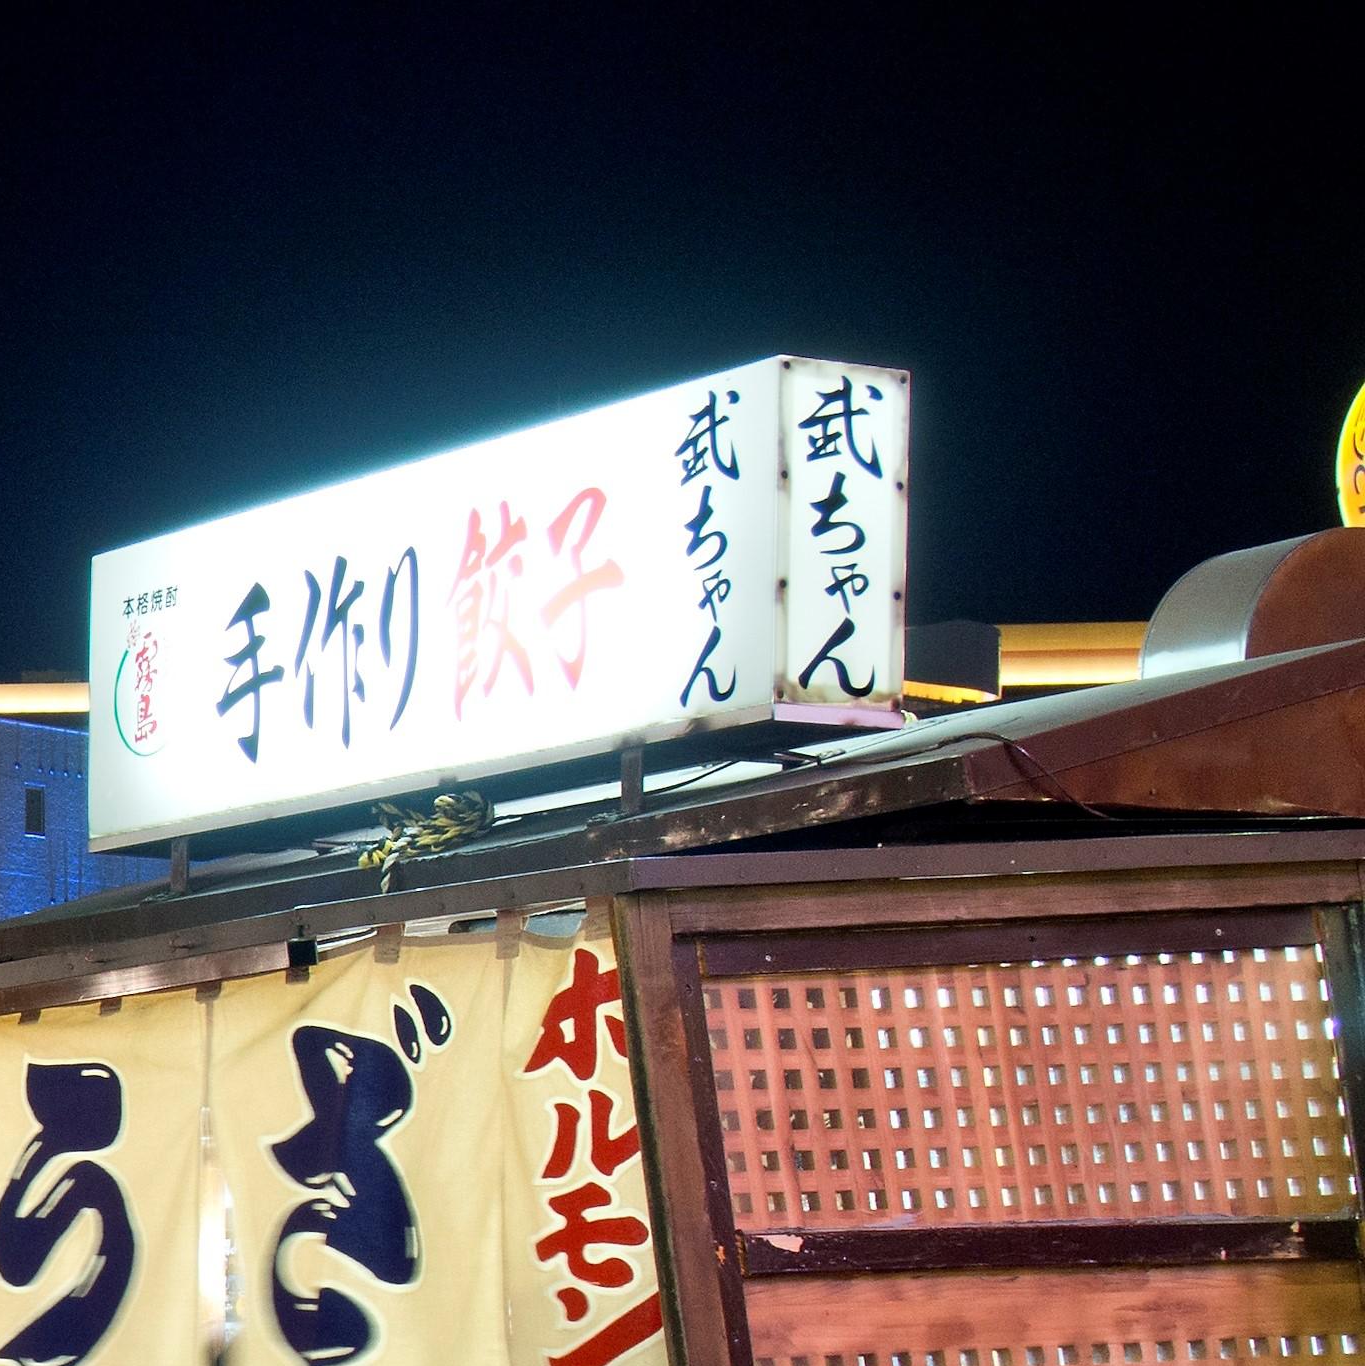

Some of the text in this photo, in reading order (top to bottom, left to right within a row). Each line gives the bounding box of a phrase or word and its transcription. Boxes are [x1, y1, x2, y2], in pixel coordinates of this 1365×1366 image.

[122, 585, 178, 619] 本格焼酎
[674, 390, 741, 707] 武ちゃん
[798, 376, 884, 699] 武ちゃん
